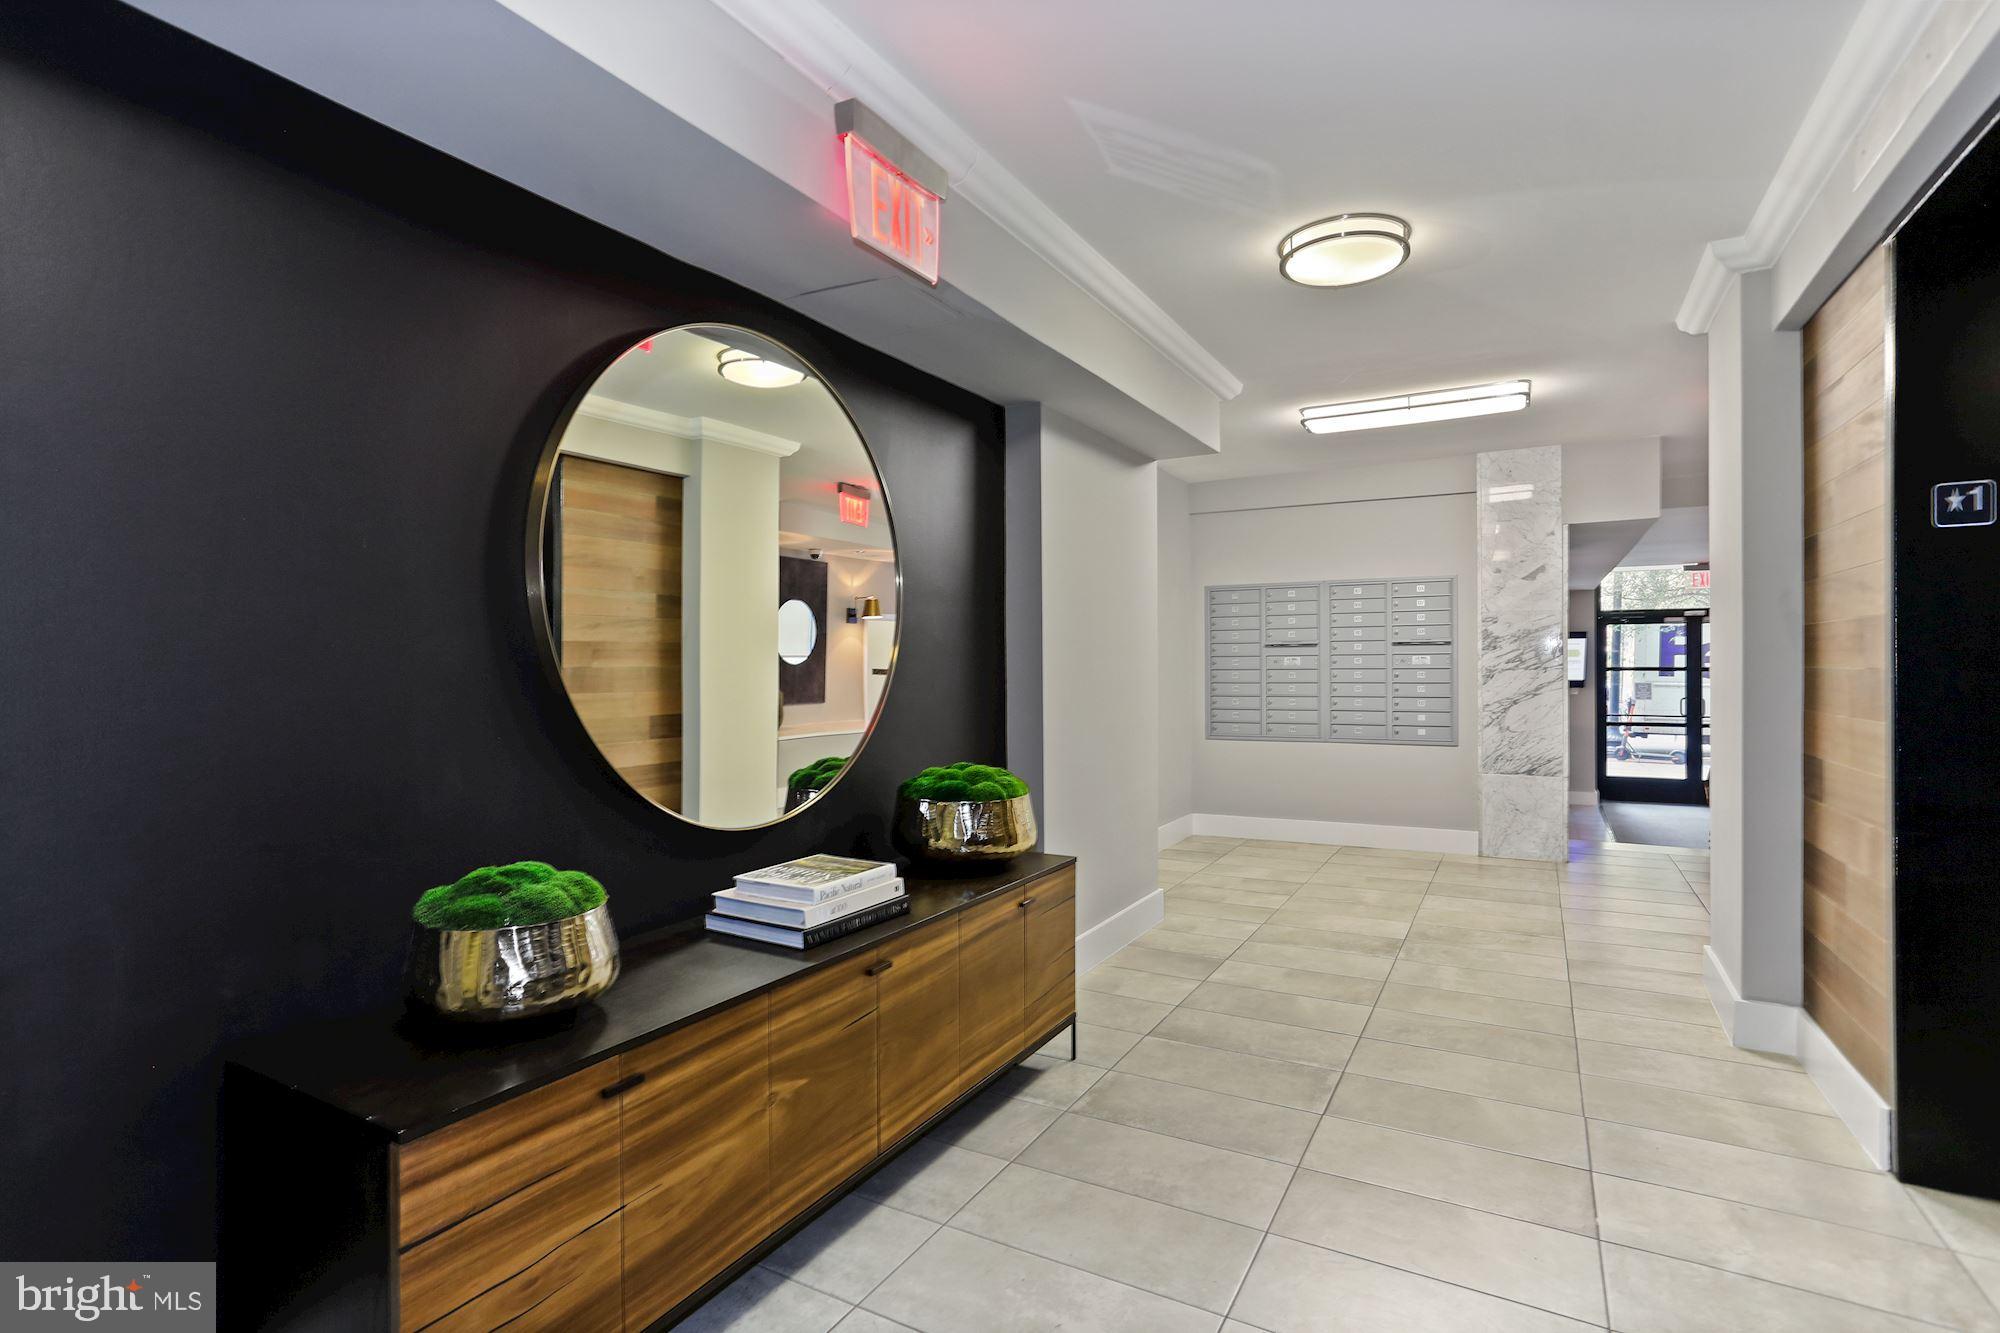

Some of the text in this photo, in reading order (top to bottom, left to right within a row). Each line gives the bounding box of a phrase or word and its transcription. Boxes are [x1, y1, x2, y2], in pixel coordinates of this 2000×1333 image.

[871, 161, 925, 267] EXIT
[1966, 485, 1984, 511] 1
[1693, 572, 1710, 587] EXI
